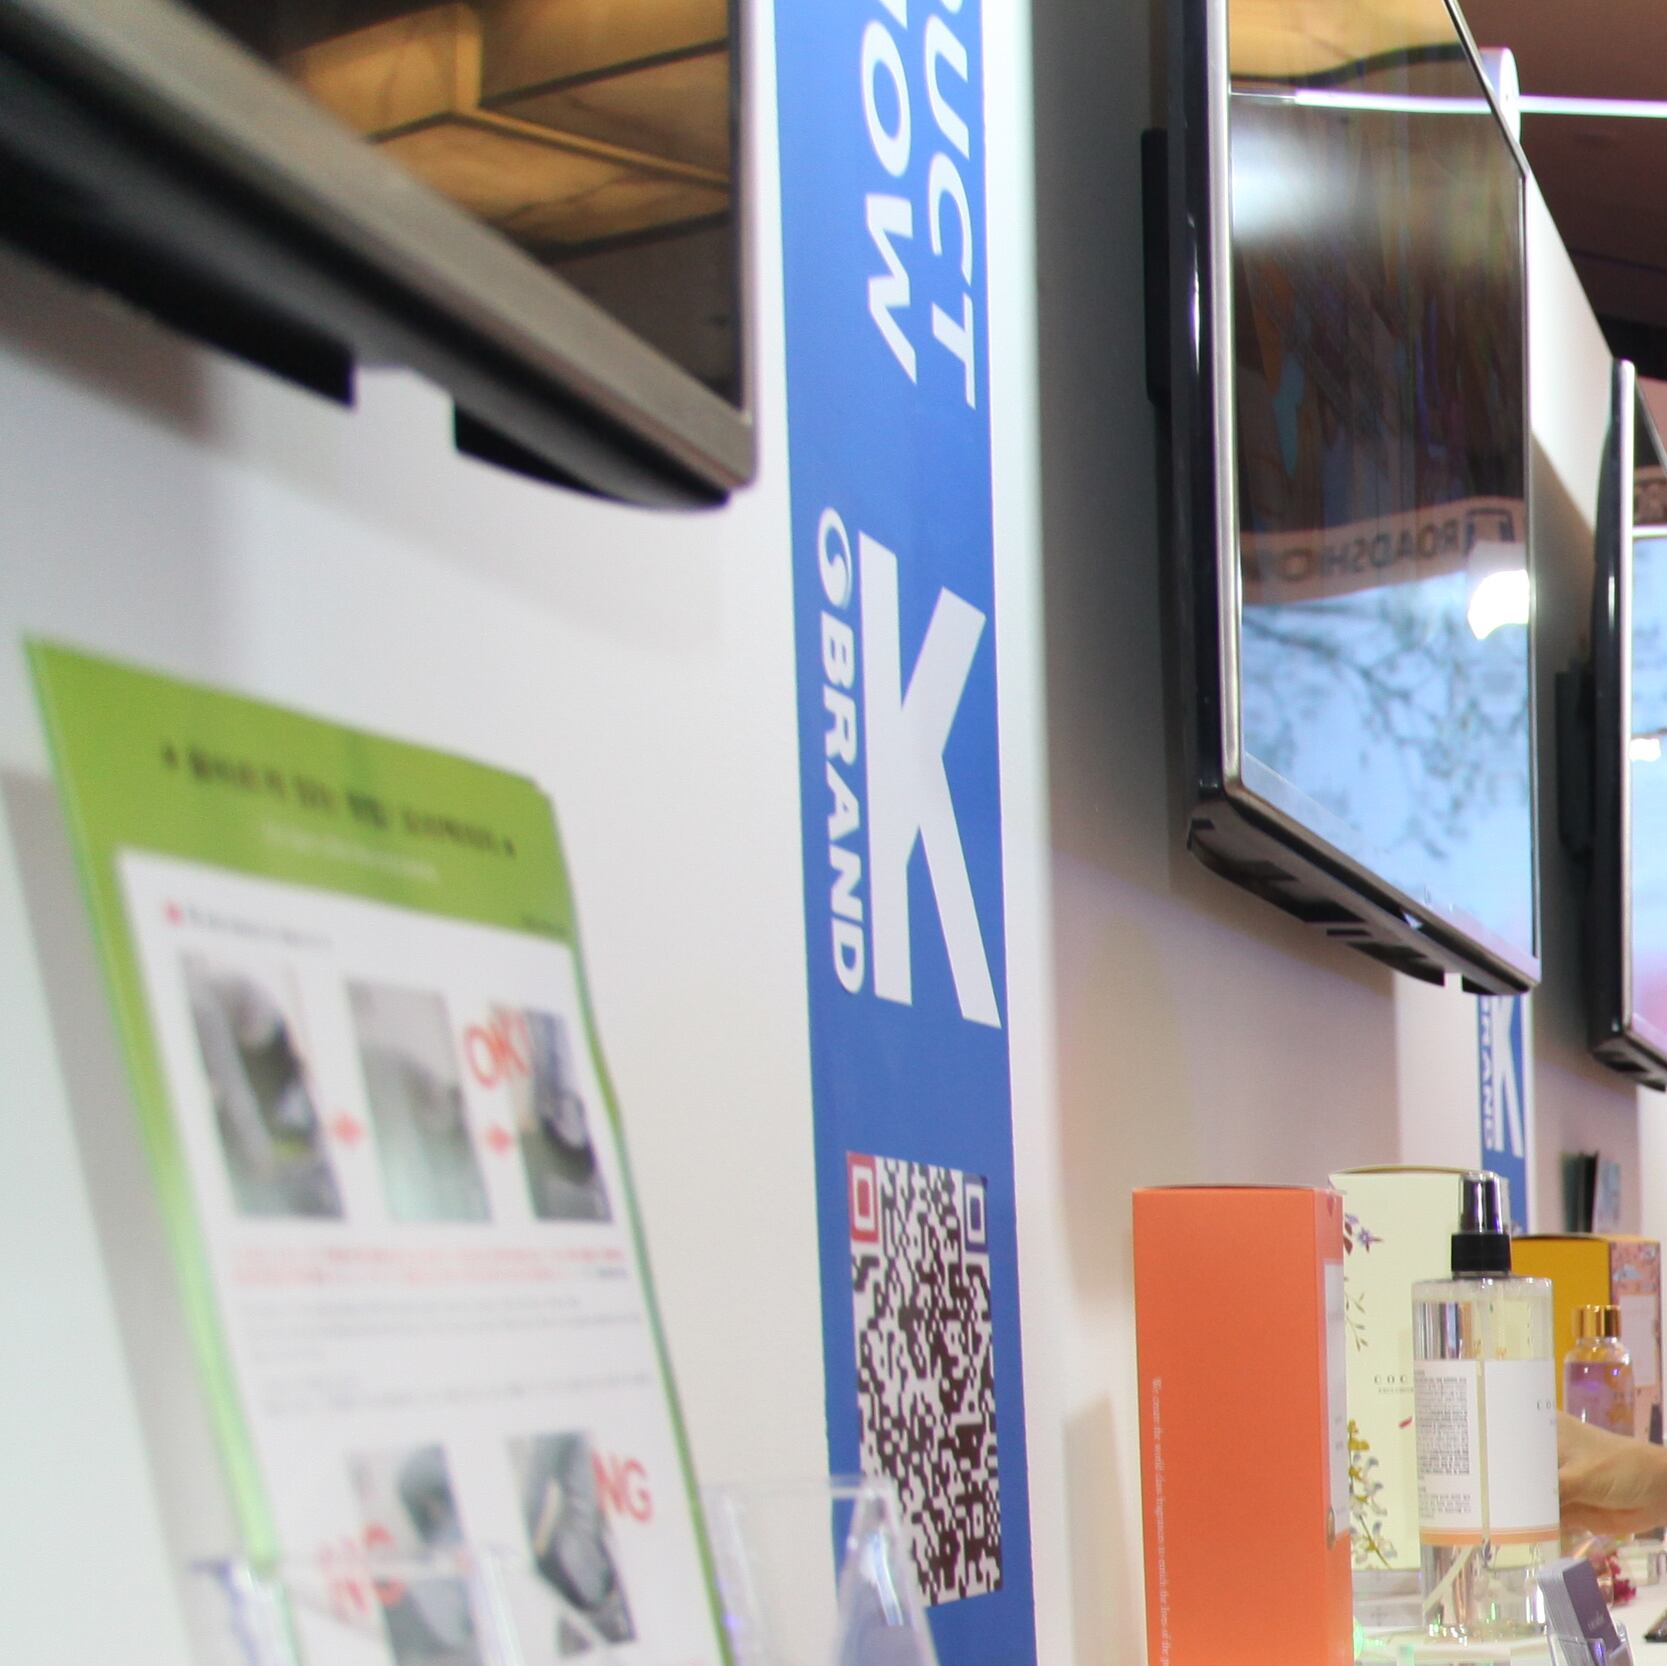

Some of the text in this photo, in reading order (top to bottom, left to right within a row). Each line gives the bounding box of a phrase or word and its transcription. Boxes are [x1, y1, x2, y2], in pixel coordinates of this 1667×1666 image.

[861, 0, 917, 385] OW
[924, 0, 976, 411] UCT
[820, 611, 865, 994] BRAND
[859, 529, 1002, 1029] K
